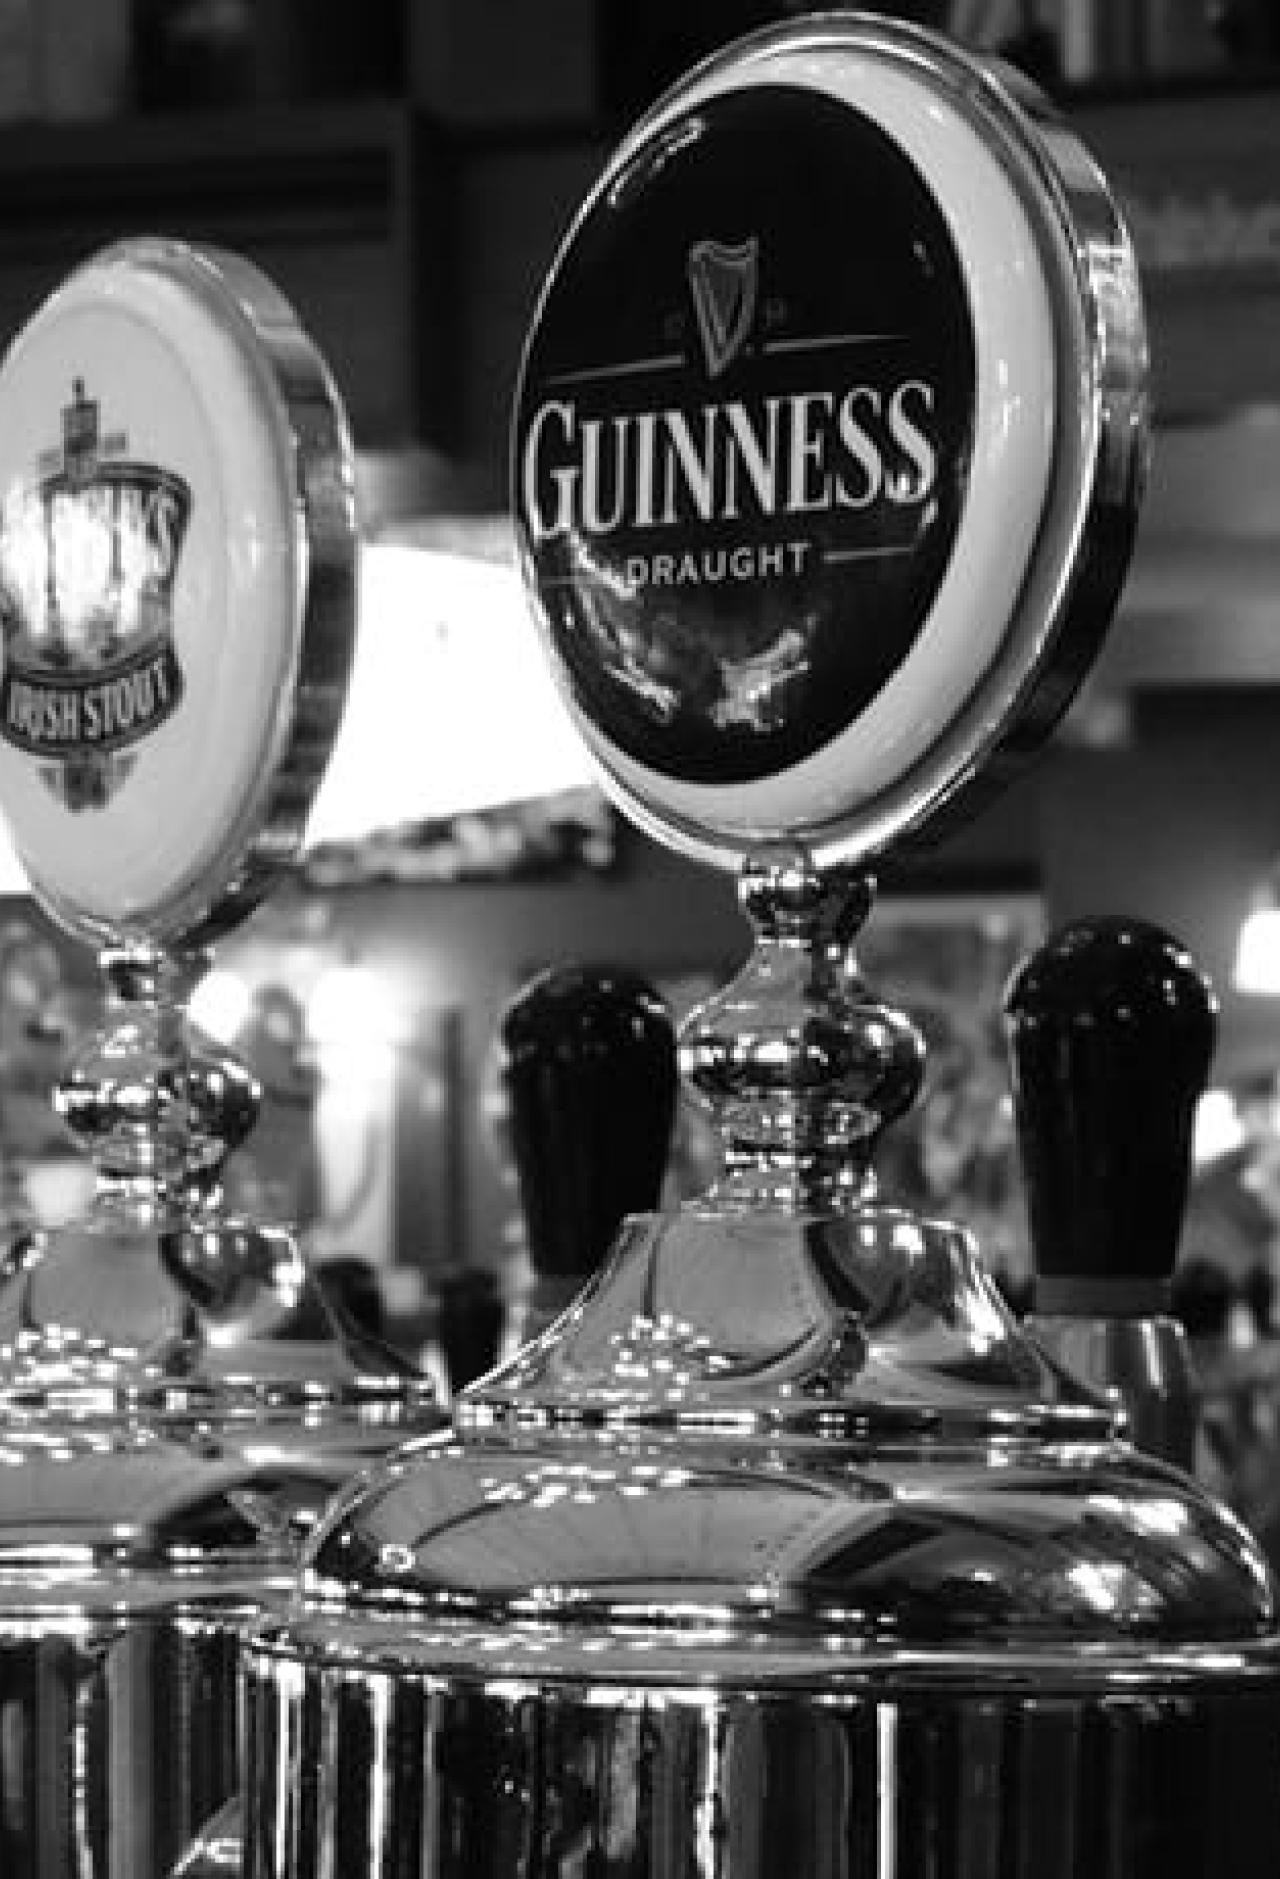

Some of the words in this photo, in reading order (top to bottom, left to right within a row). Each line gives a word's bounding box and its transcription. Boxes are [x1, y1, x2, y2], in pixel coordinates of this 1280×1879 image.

[524, 379, 937, 545] GUINNESS
[628, 541, 813, 586] DRAUGHT
[9, 680, 79, 741] IRISH
[83, 656, 168, 741] STOUT
